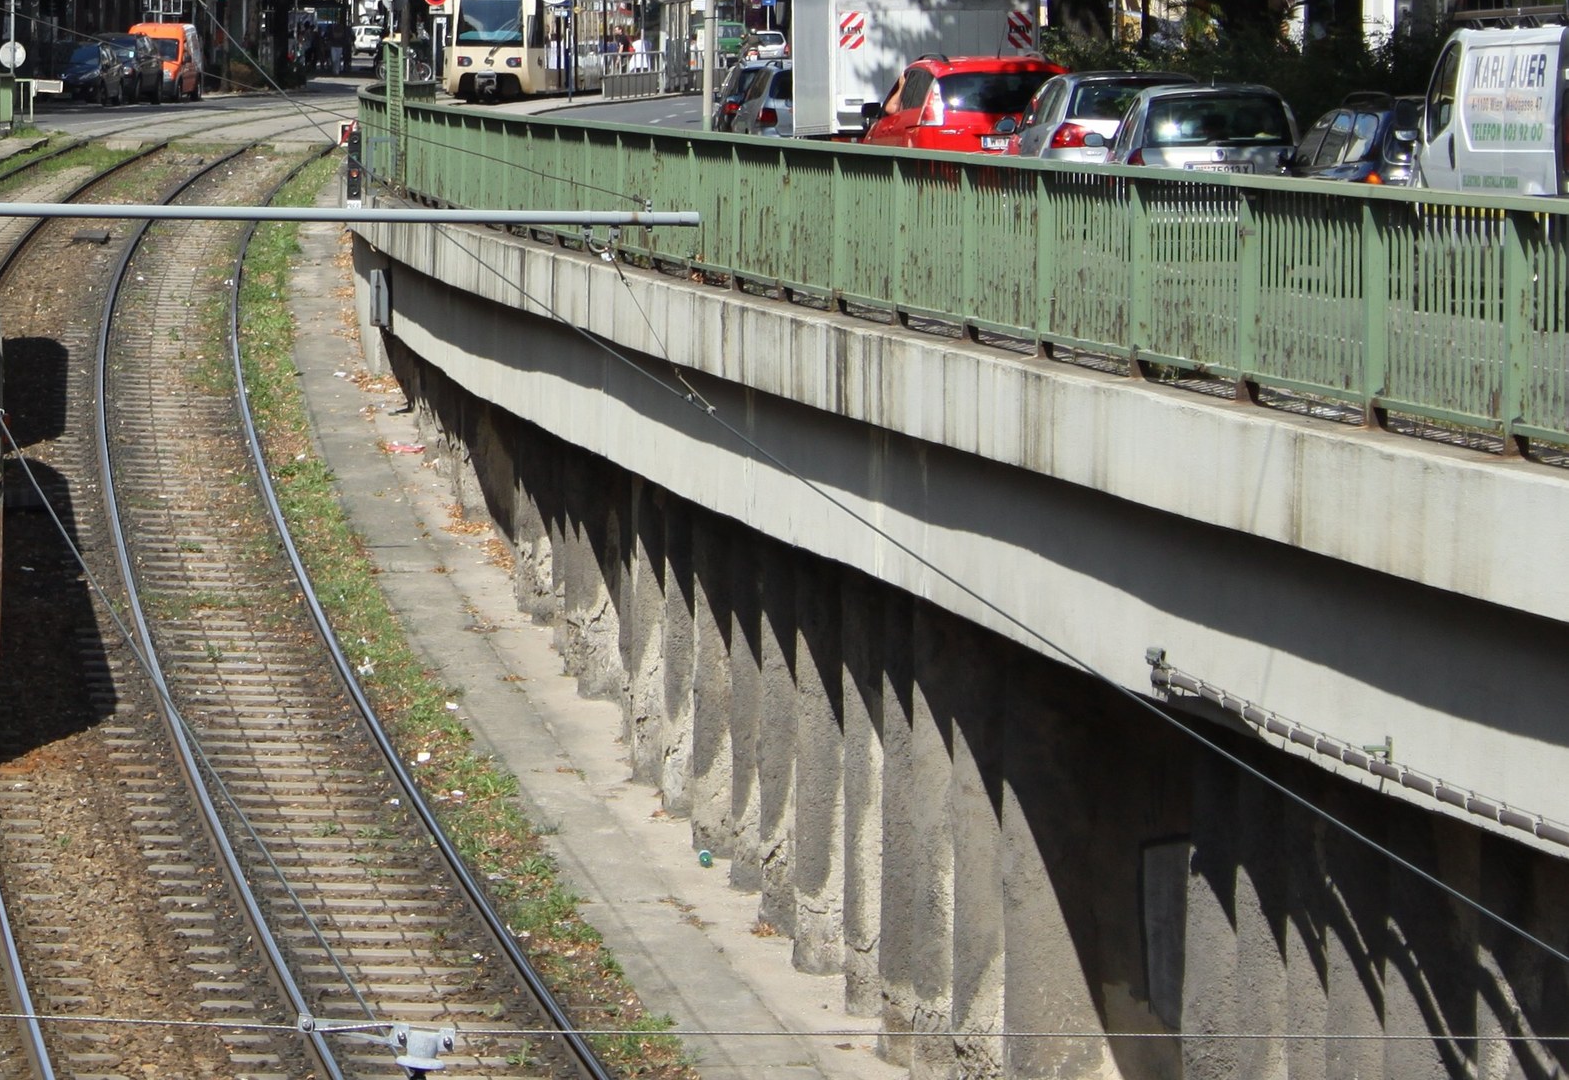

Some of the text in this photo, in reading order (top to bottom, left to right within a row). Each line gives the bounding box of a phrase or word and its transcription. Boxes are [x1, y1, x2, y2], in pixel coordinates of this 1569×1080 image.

[1473, 53, 1547, 88] KARL AUER
[1535, 97, 1543, 109] 47
[1472, 123, 1543, 141] TELEFON 603 92 00
